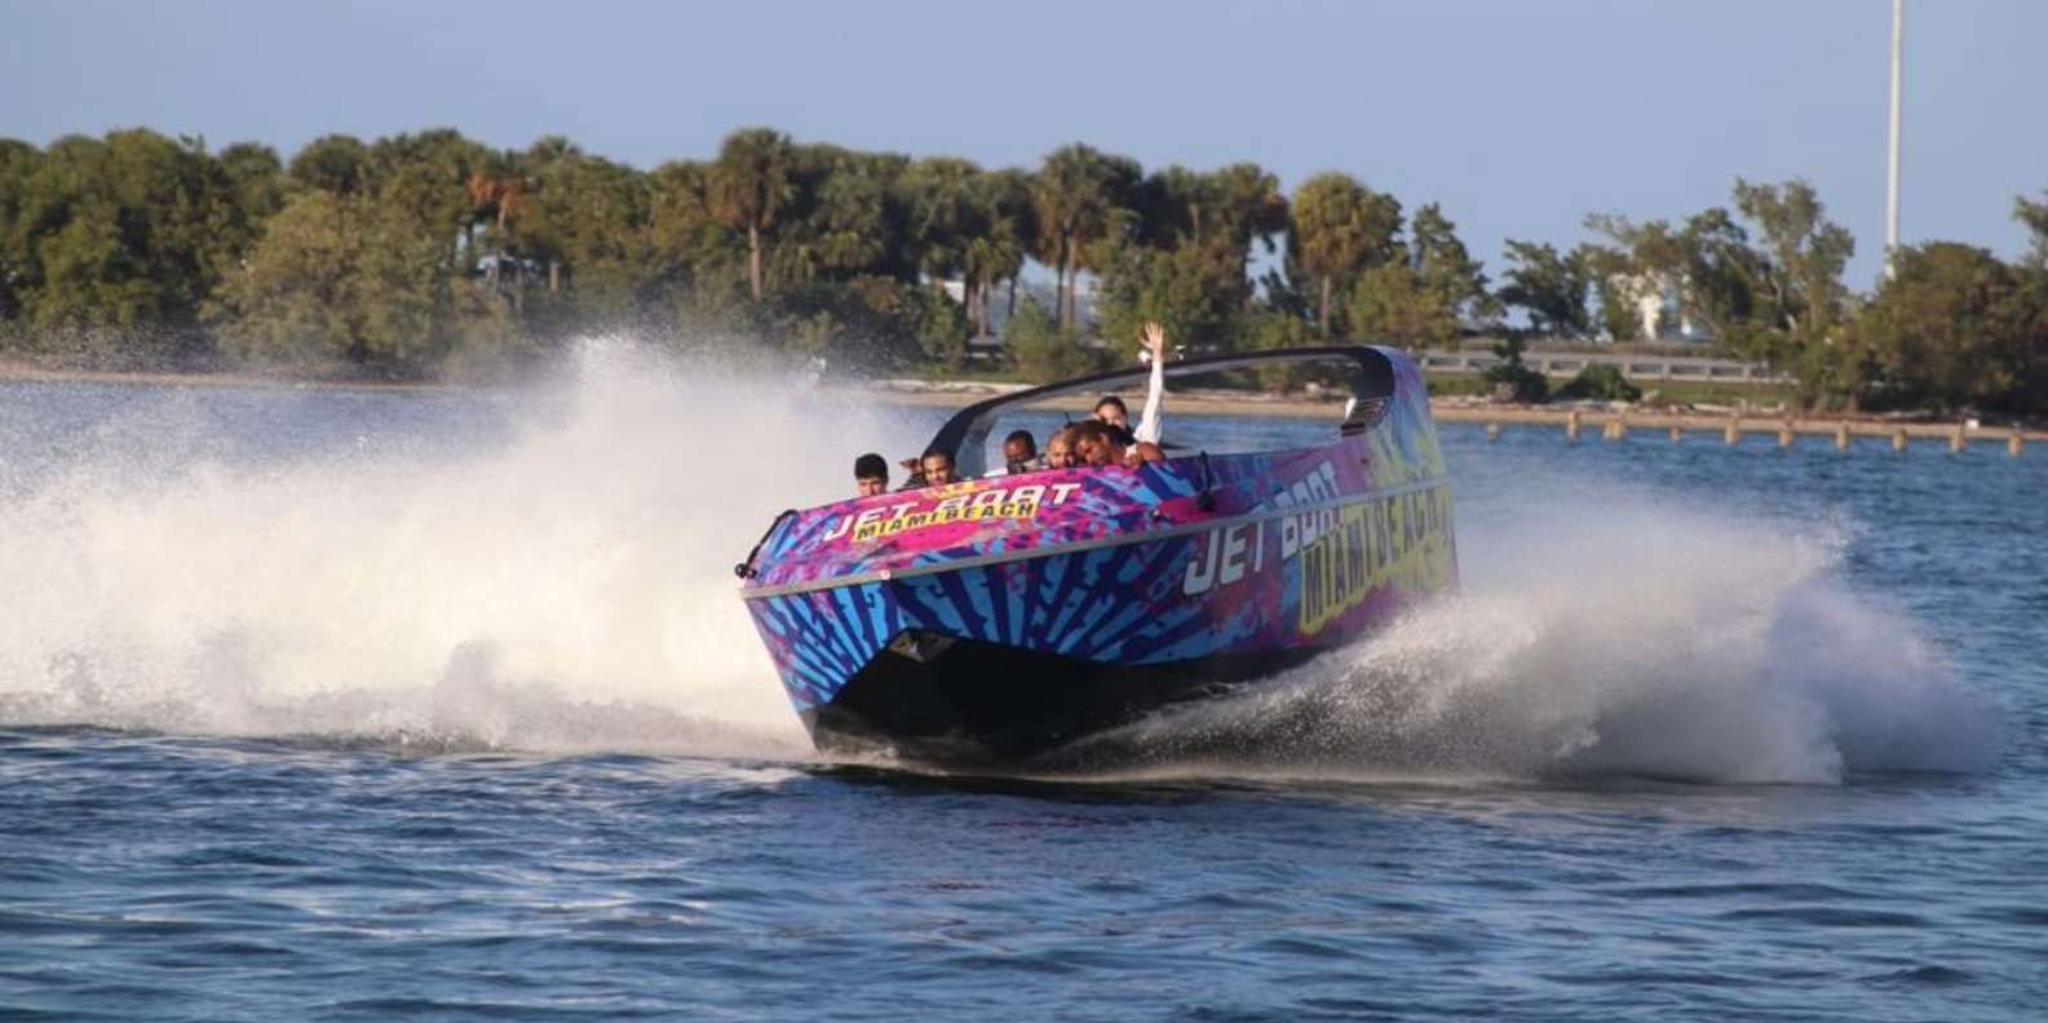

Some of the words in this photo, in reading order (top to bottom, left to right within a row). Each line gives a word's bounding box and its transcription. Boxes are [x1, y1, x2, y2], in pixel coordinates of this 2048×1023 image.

[823, 501, 918, 541] JET
[931, 483, 1081, 516] BOAT
[856, 509, 938, 540] MIAMI
[945, 503, 1034, 521] BEACH
[1183, 503, 1266, 595] JET
[1274, 460, 1345, 560] BOAT
[1304, 504, 1372, 624] MIAMI
